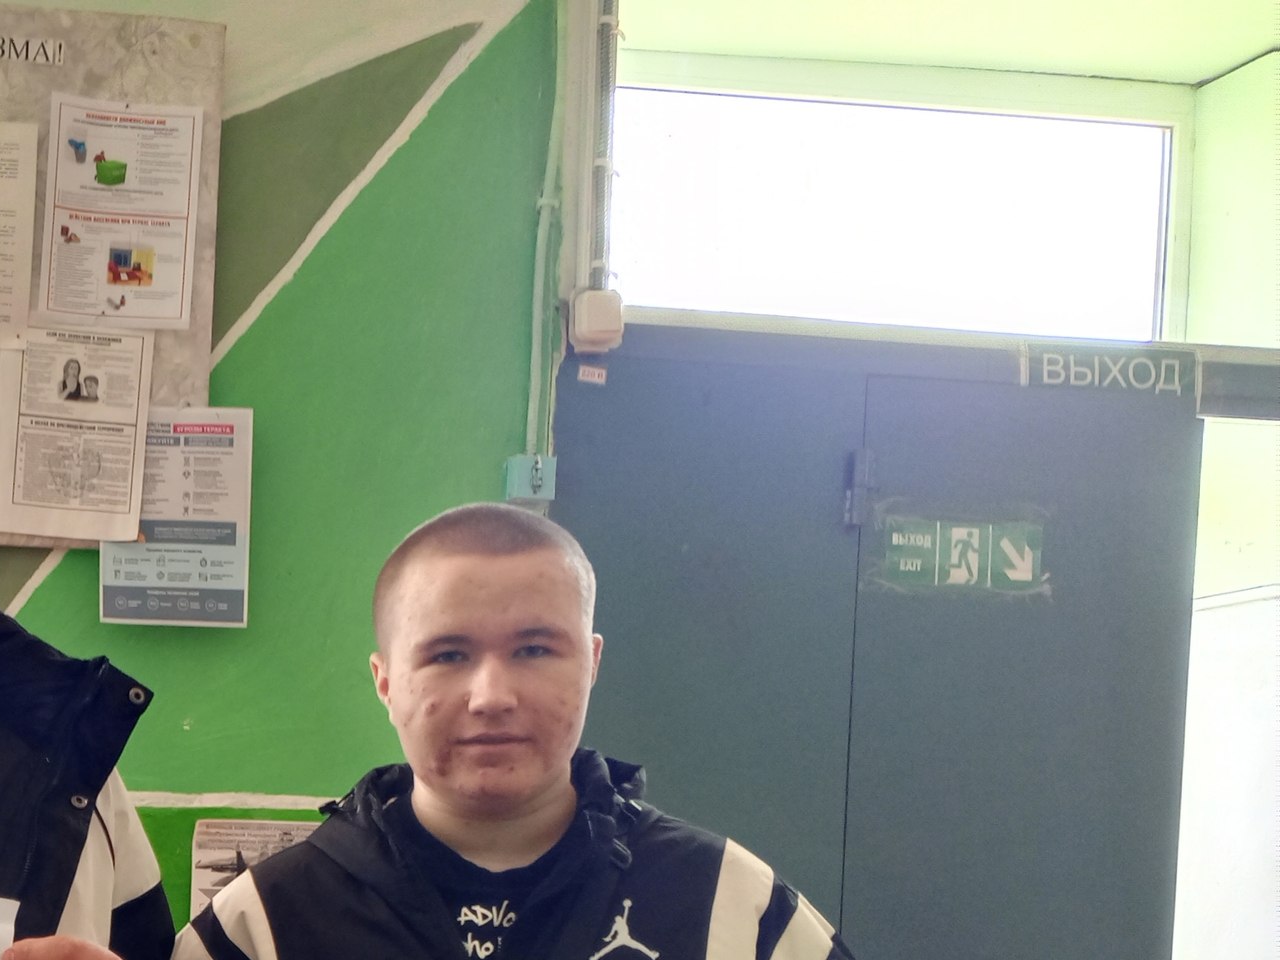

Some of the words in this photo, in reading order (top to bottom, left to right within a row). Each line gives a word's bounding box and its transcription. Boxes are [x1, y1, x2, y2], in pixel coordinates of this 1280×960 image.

[1043, 353, 1181, 396] ВЫХОД
[892, 532, 932, 548] ВЫХОД
[900, 558, 923, 571] EXIT
